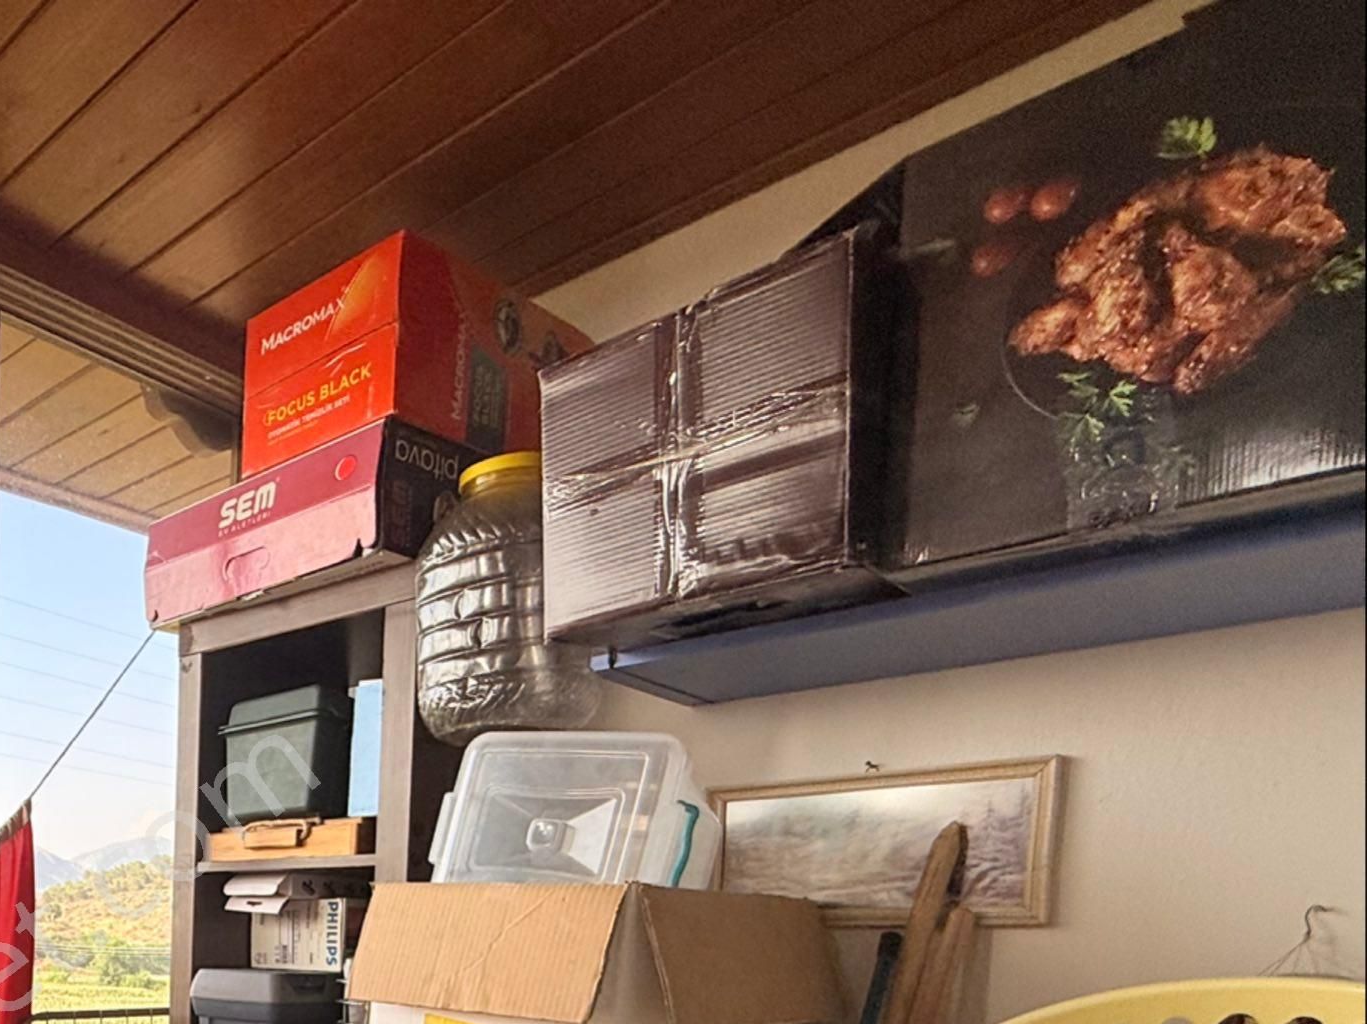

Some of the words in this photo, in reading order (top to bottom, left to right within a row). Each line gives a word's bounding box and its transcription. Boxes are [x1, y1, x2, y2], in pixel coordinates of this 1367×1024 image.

[260, 298, 345, 356] MACROMAX
[266, 391, 315, 426] FOCUS
[319, 362, 372, 401] BLACK
[395, 440, 459, 481] pitava
[218, 481, 277, 529] SEM
[325, 901, 339, 966] PHILIPS
